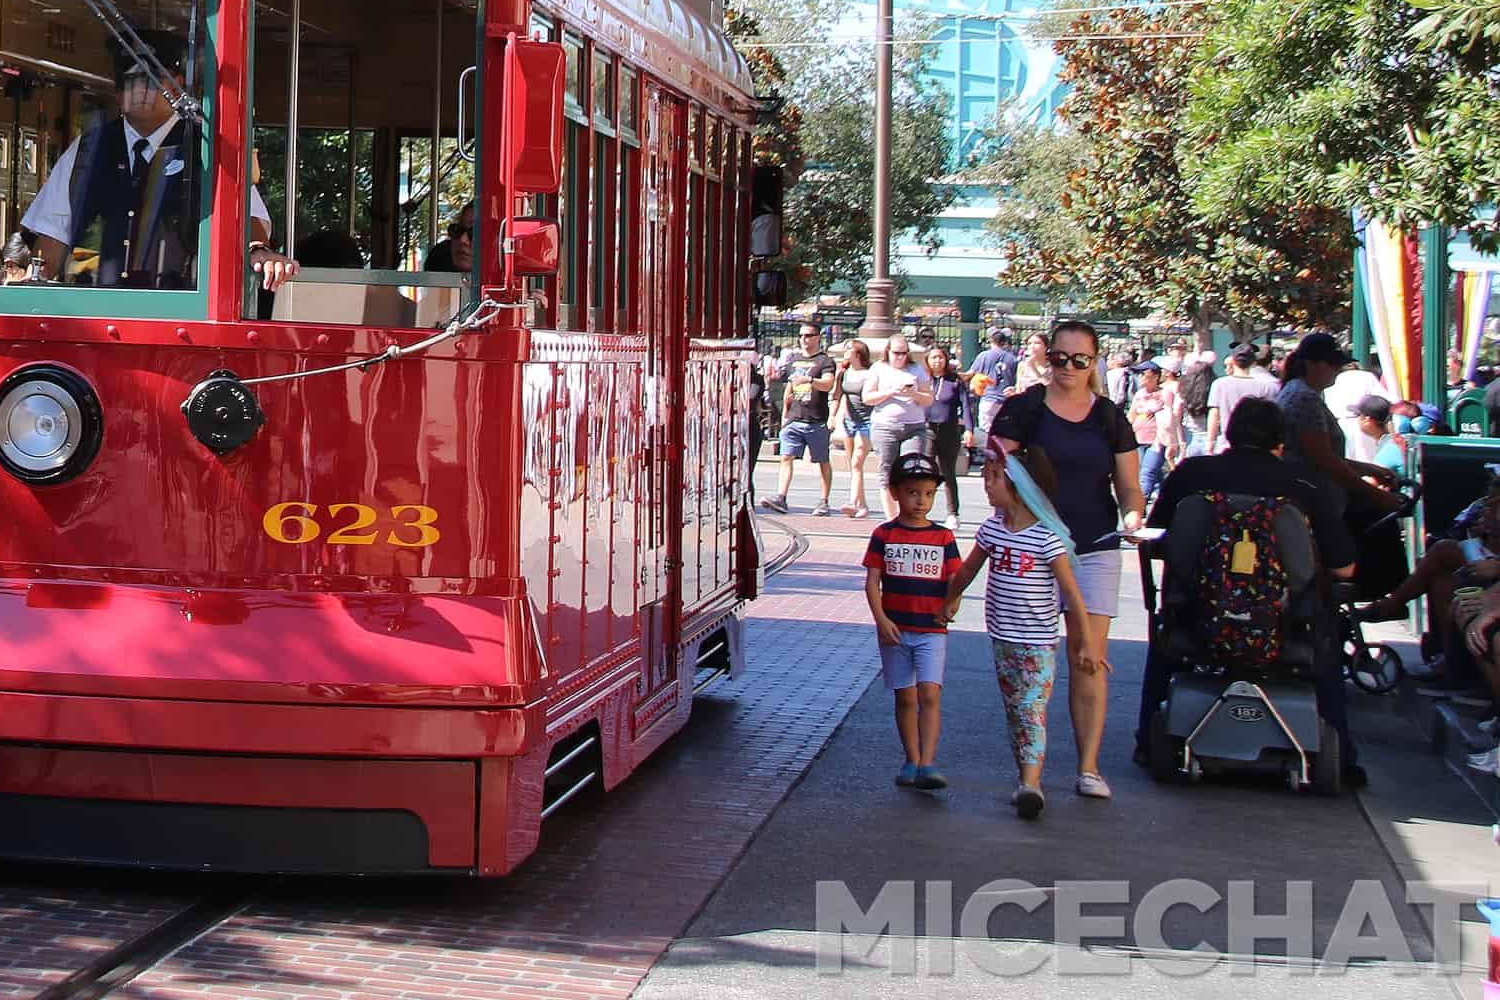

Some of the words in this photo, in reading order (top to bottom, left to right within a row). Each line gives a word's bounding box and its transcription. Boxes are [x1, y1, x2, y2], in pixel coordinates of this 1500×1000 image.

[263, 502, 441, 547] 623
[886, 547, 910, 559] GAP
[913, 548, 939, 561] NYC
